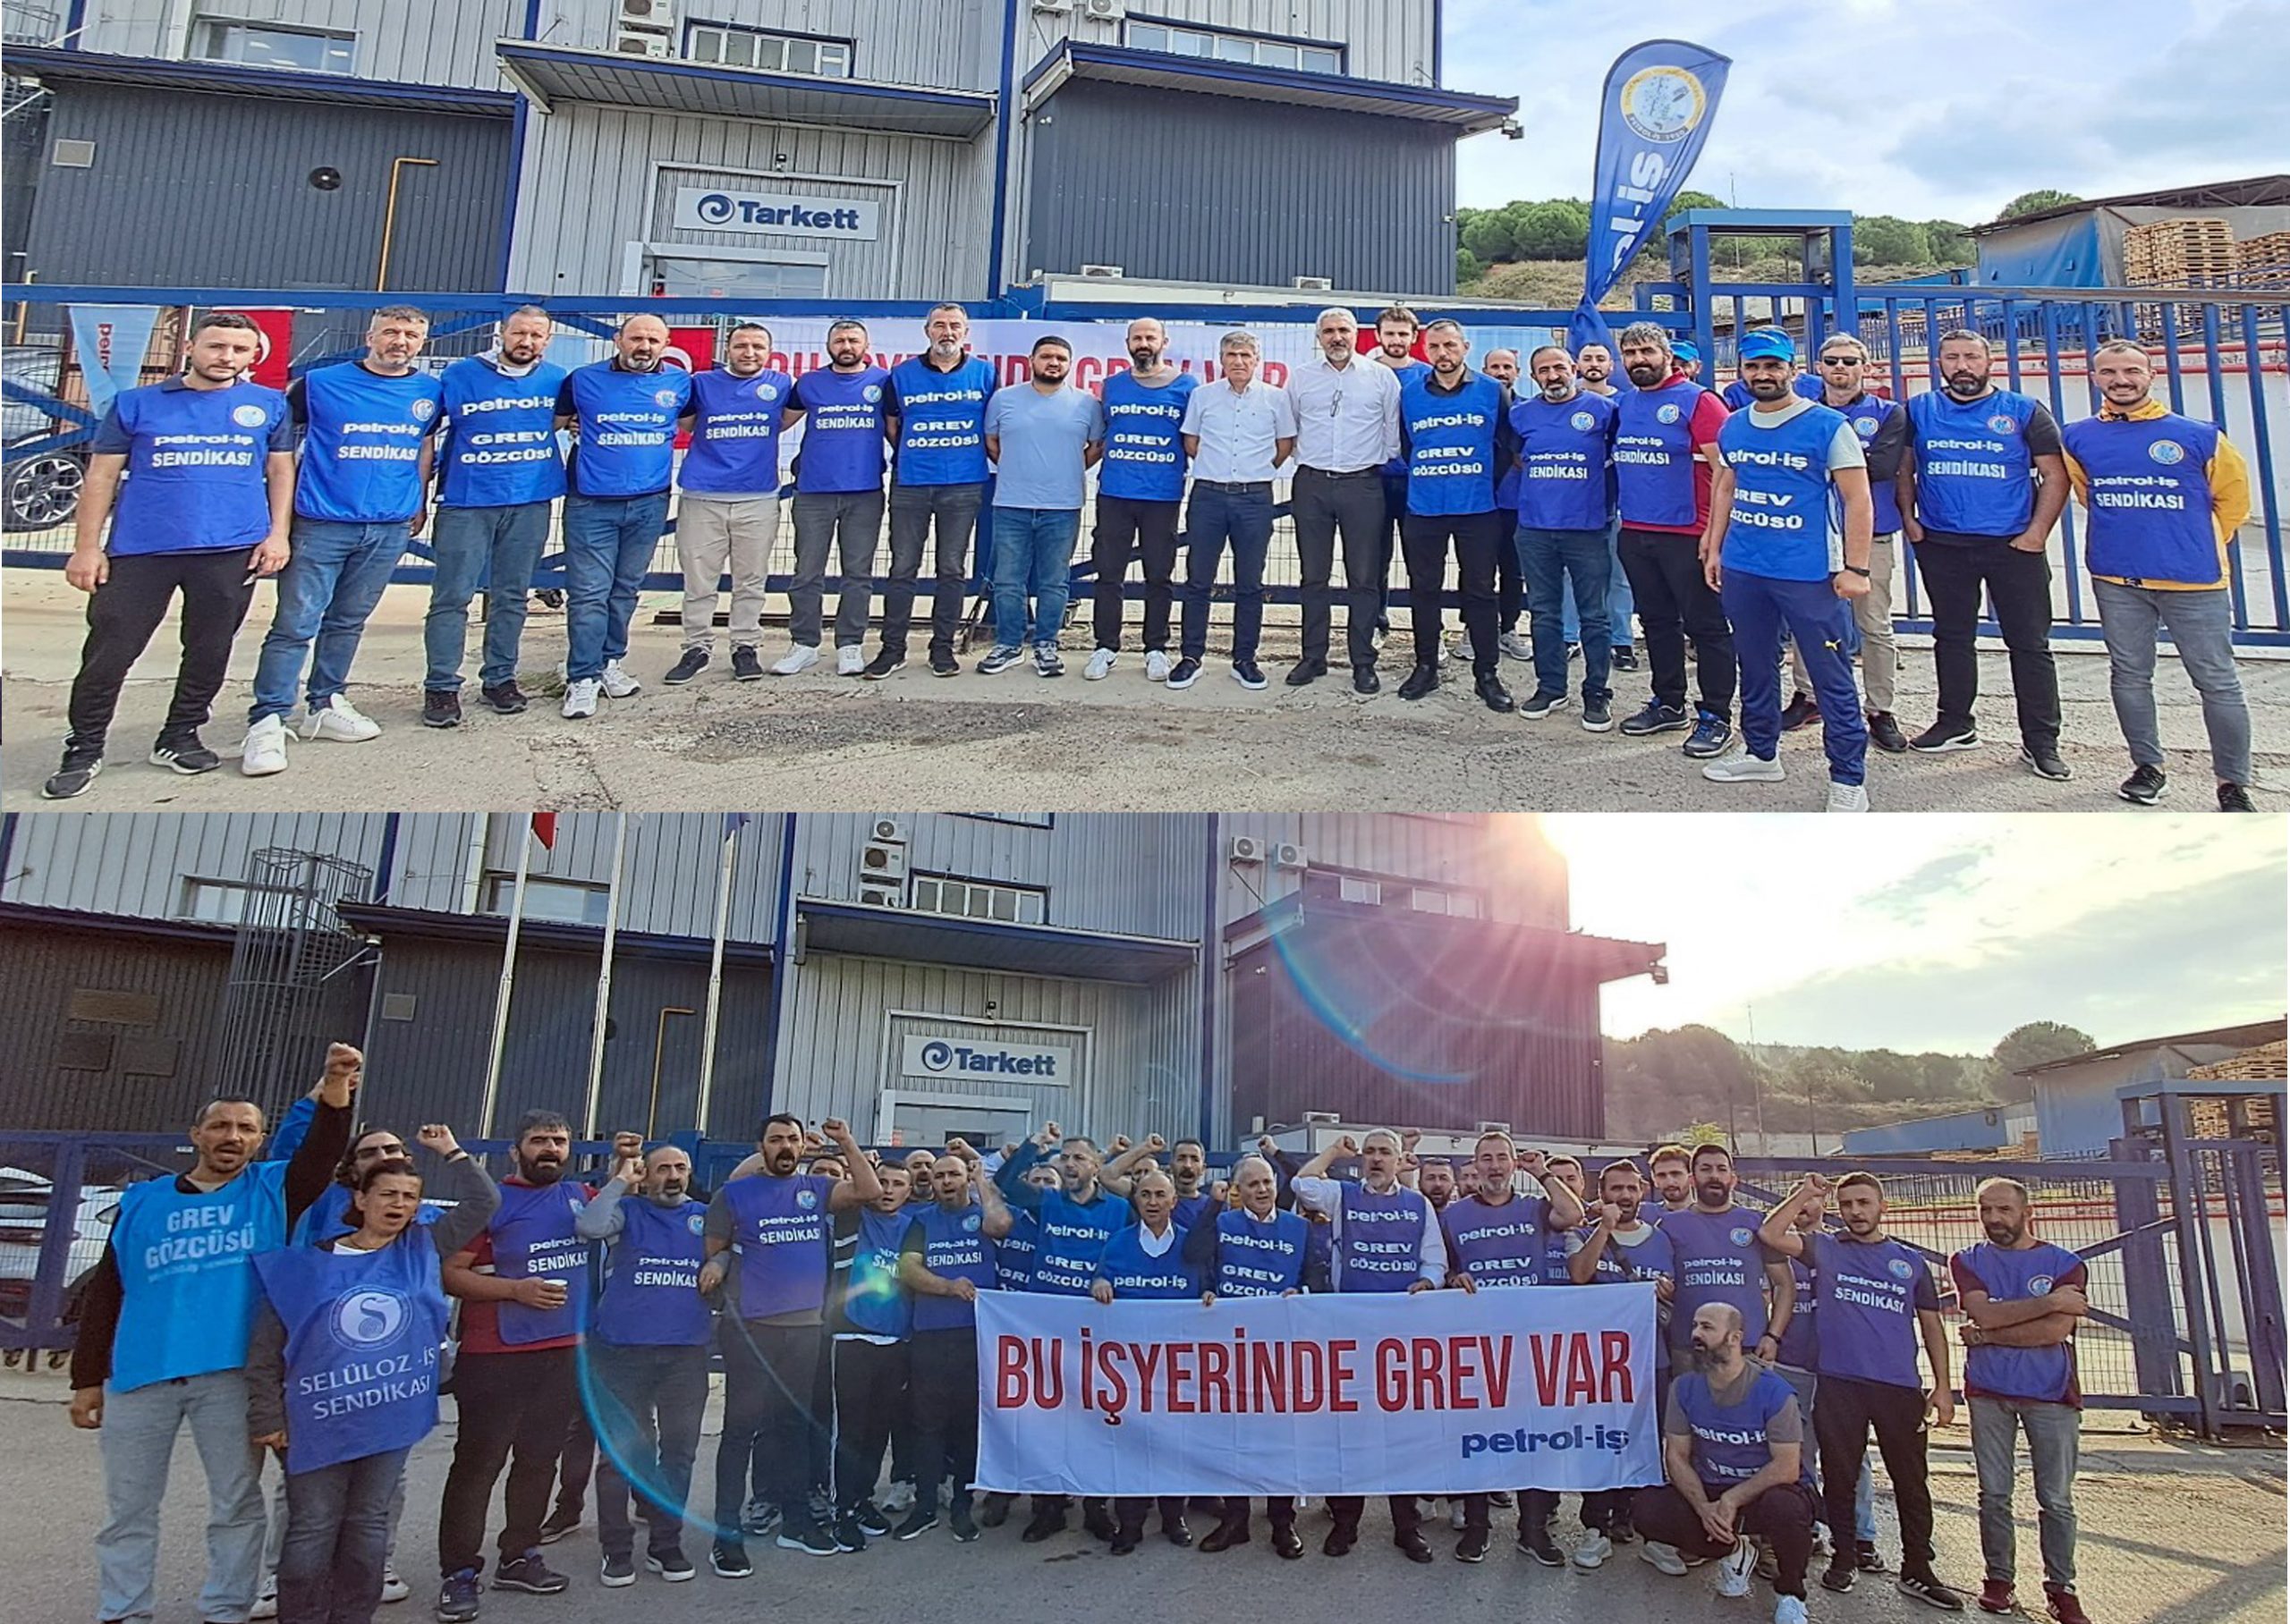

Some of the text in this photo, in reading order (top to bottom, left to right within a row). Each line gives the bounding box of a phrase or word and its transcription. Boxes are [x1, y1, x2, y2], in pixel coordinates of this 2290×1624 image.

[738, 200, 860, 230] Tarkett
[462, 396, 556, 416] petrol-iş
[904, 389, 983, 407] petrol-iş
[818, 403, 874, 414] petrol-iş
[1110, 403, 1181, 420] petrol-iş
[598, 412, 666, 424] petrol-iş
[708, 411, 769, 424] petrol-iş
[816, 414, 875, 429] SENDİKASI
[912, 419, 974, 432] GREV
[1412, 413, 1484, 433] petrol-iş
[343, 421, 420, 438] petrol-iş
[471, 430, 548, 445] GREV
[706, 425, 769, 439] SENDİKASI
[153, 434, 254, 447] petrol-iş
[598, 431, 665, 446] SENDİKASI
[906, 433, 980, 449] GÖZCÜSÜ
[1114, 433, 1171, 446] GREV
[1616, 436, 1663, 447] petrol-iş
[1927, 439, 2004, 453] petrol-iş
[151, 450, 252, 468] SENDİKASI
[337, 444, 418, 461] SENDİKASI
[1108, 448, 1175, 462] GÖZCÜSÜ
[1418, 446, 1475, 460] GREV
[1530, 452, 1587, 461] petrol-iş
[1613, 449, 1669, 465] SENDİKASI
[1726, 449, 1808, 470] etrol-iş
[1412, 462, 1483, 477] GÖZCÜSÜ
[1529, 463, 1588, 480] SENDİKASI
[1927, 461, 2006, 478] SENDİKASI
[2093, 476, 2179, 488] petrol-iş
[2095, 491, 2184, 510] SENDİKASI
[954, 1047, 1056, 1076] Tarkett
[167, 1204, 235, 1233] GREV
[759, 1214, 819, 1228] petrol-iş
[1347, 1209, 1419, 1223] petrol-iş
[759, 1227, 821, 1245] SENDİKASI
[1458, 1222, 1536, 1245] petrol-iş
[145, 1222, 256, 1270] GÖZCÜSÜ
[1220, 1232, 1294, 1256] petrol-iş
[1353, 1241, 1412, 1254] GREV
[927, 1251, 982, 1267] SENDİKASI
[1045, 1255, 1098, 1272] GREV
[1350, 1258, 1417, 1273] GÖZCÜSÜ
[1469, 1257, 1532, 1272] GREV
[1683, 1259, 1743, 1270] petrol-iş
[634, 1271, 698, 1288] SENDİKAS
[999, 1268, 1030, 1284] GR
[1037, 1270, 1091, 1290] GÖZCÜS
[1223, 1264, 1285, 1283] GREV
[1474, 1273, 1539, 1288] ÖZCÜSÜ
[1684, 1271, 1745, 1287] SENDİKASI
[1114, 1274, 1188, 1290] petrol-iş
[1837, 1273, 1906, 1295] petrol-iş
[1835, 1288, 1904, 1315] SENDİKASI
[299, 1354, 412, 1396] SELÜLOZ
[997, 1326, 1634, 1425] BU İŞYERİNDE GREV VAR
[312, 1375, 430, 1420] SENDİKASI
[1461, 1425, 1630, 1459] petrol-iş
